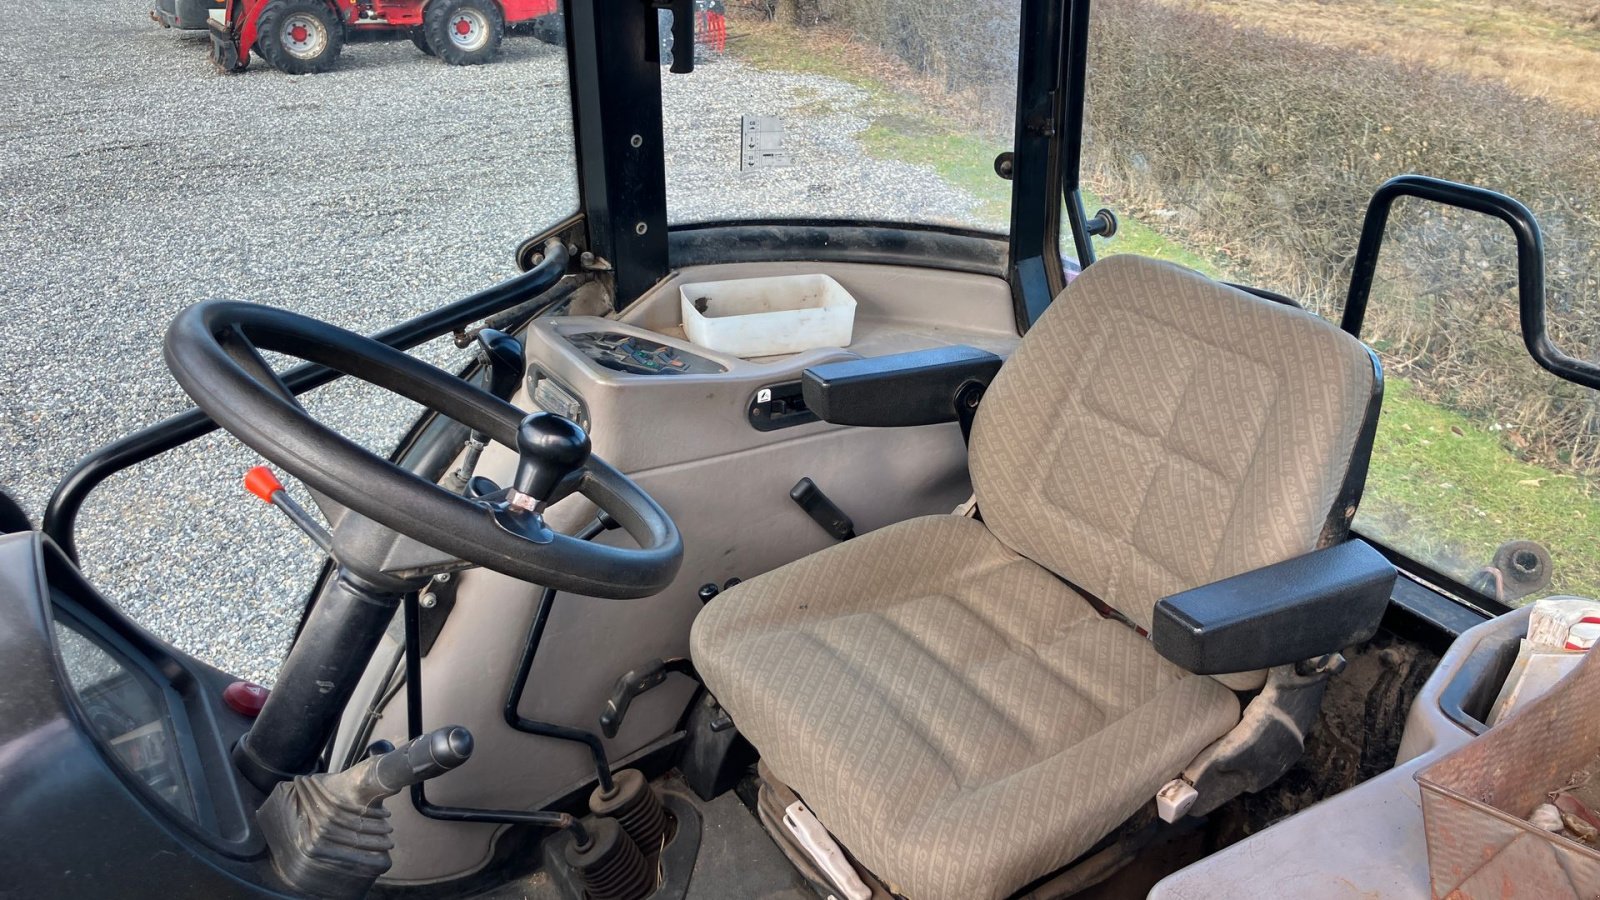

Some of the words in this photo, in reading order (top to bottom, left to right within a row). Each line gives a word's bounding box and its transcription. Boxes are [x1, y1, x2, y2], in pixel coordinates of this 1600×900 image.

[1306, 362, 1320, 395] CASE
[1314, 413, 1329, 450] CASE
[1300, 445, 1316, 479] CASE
[1286, 475, 1303, 509] CASE
[1273, 506, 1293, 540] CASE
[864, 741, 882, 769] CASE
[869, 769, 888, 799] CASE
